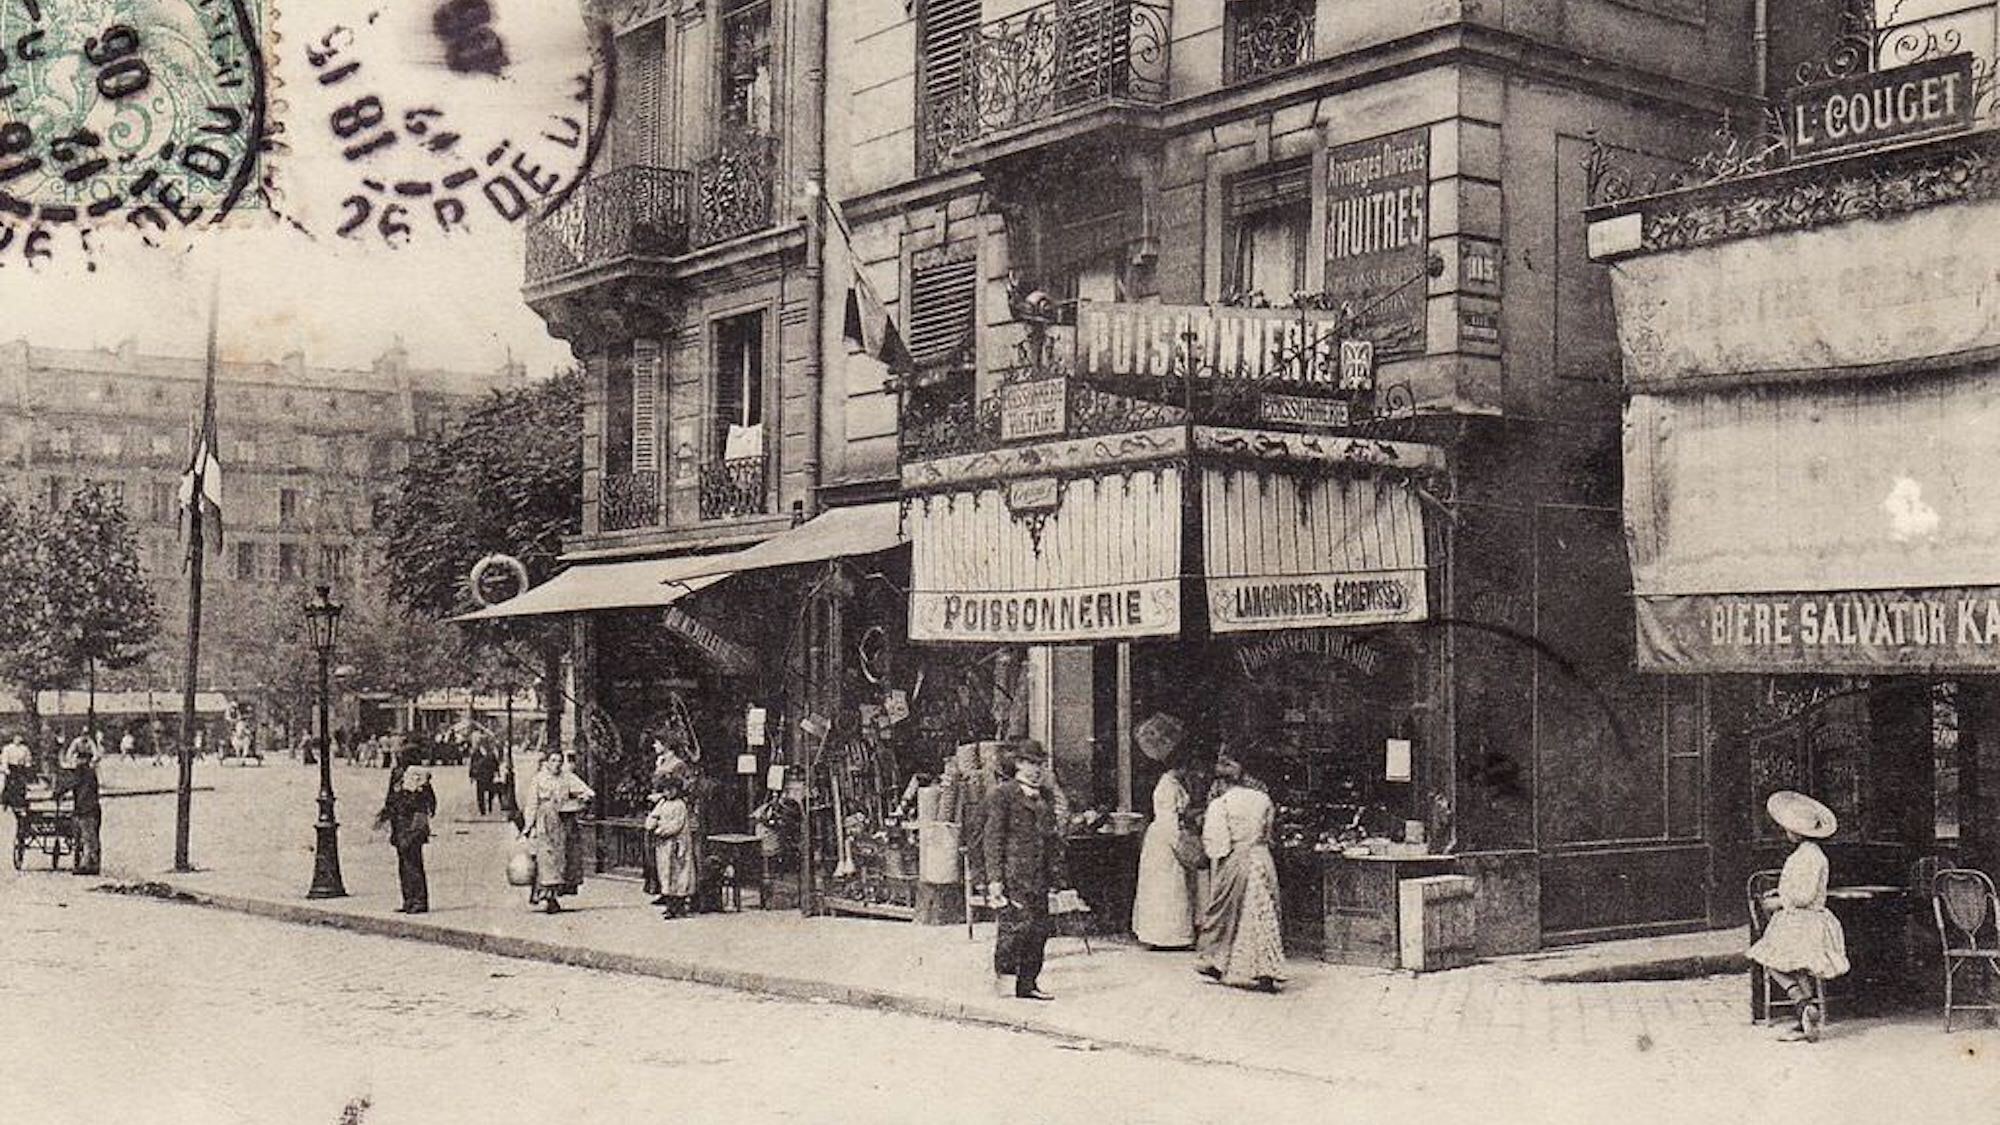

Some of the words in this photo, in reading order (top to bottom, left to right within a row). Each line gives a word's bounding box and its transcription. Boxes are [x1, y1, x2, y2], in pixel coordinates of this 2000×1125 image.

[1088, 310, 1338, 382] POISSONNERIE
[943, 590, 1142, 632] POISSONNERIE
[1236, 582, 1323, 618] LANGOUSTES
[1800, 599, 1946, 644] SALVATOR
